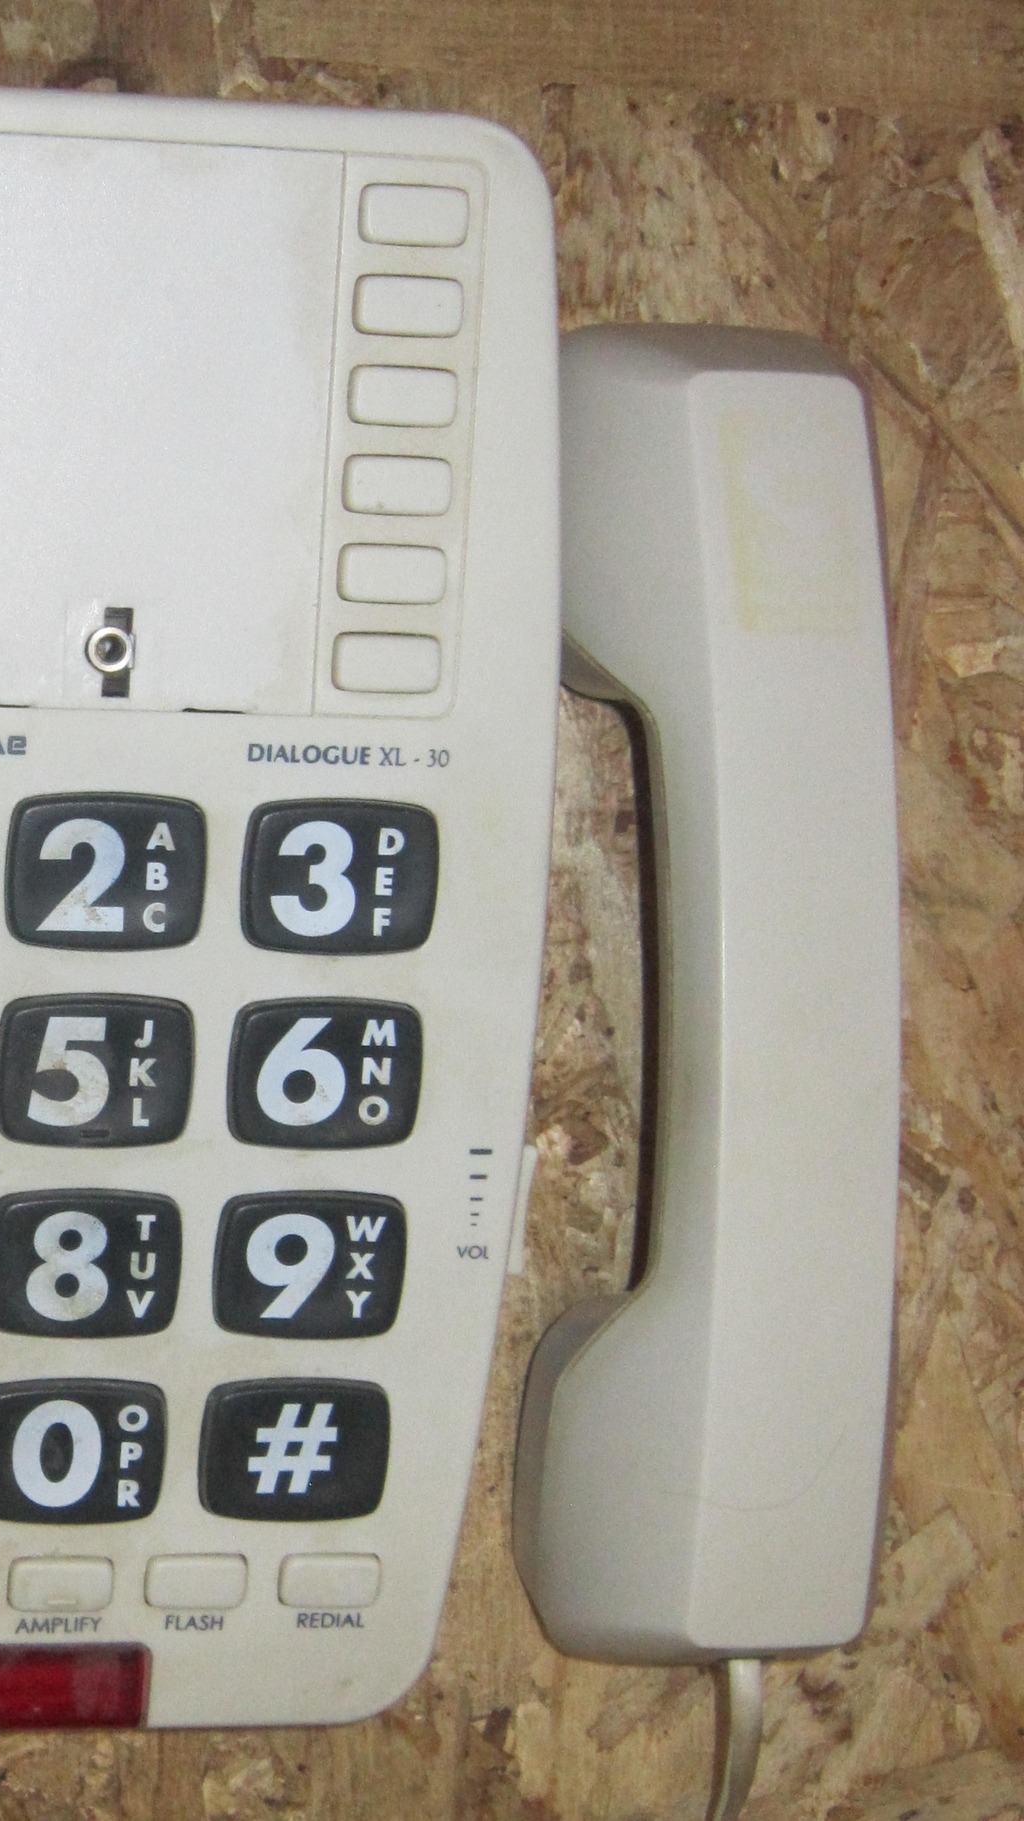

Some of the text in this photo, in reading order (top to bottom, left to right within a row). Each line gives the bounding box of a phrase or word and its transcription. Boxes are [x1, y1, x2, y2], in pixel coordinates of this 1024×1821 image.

[246, 742, 373, 767] DIALOGUE
[378, 746, 407, 767] XL
[426, 748, 450, 768] 30
[35, 818, 126, 933] 2
[270, 820, 356, 938] 3
[27, 1016, 110, 1127] 5
[256, 1017, 346, 1127] 6
[25, 1210, 109, 1322] 8
[245, 1213, 336, 1319] 9
[456, 1245, 489, 1260] VOL
[11, 1399, 102, 1508] 0
[15, 1616, 101, 1634] AMPLIFY
[165, 1614, 224, 1631] FLASH
[297, 1612, 364, 1629] REDIAL
